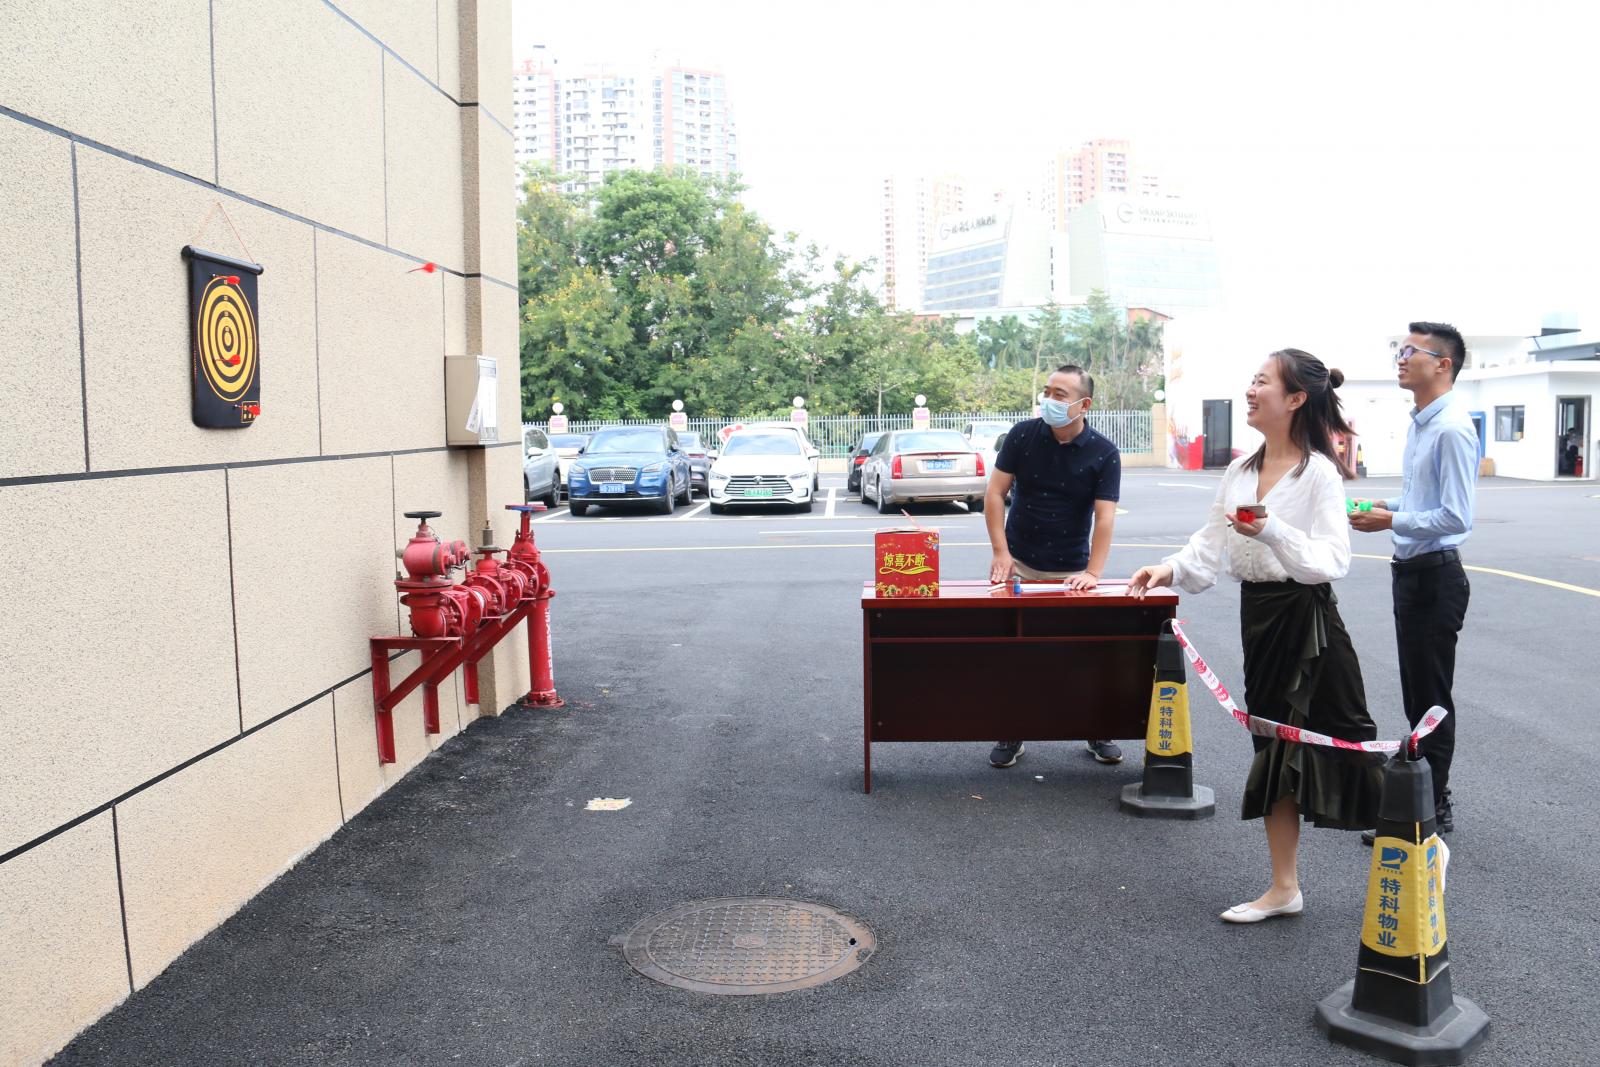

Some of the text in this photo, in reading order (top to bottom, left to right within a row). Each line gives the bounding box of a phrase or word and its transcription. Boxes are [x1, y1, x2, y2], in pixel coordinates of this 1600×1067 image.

[883, 552, 927, 570] 惊喜不断
[1158, 706, 1174, 750] 特科物业
[1376, 876, 1402, 948] 特科物业
